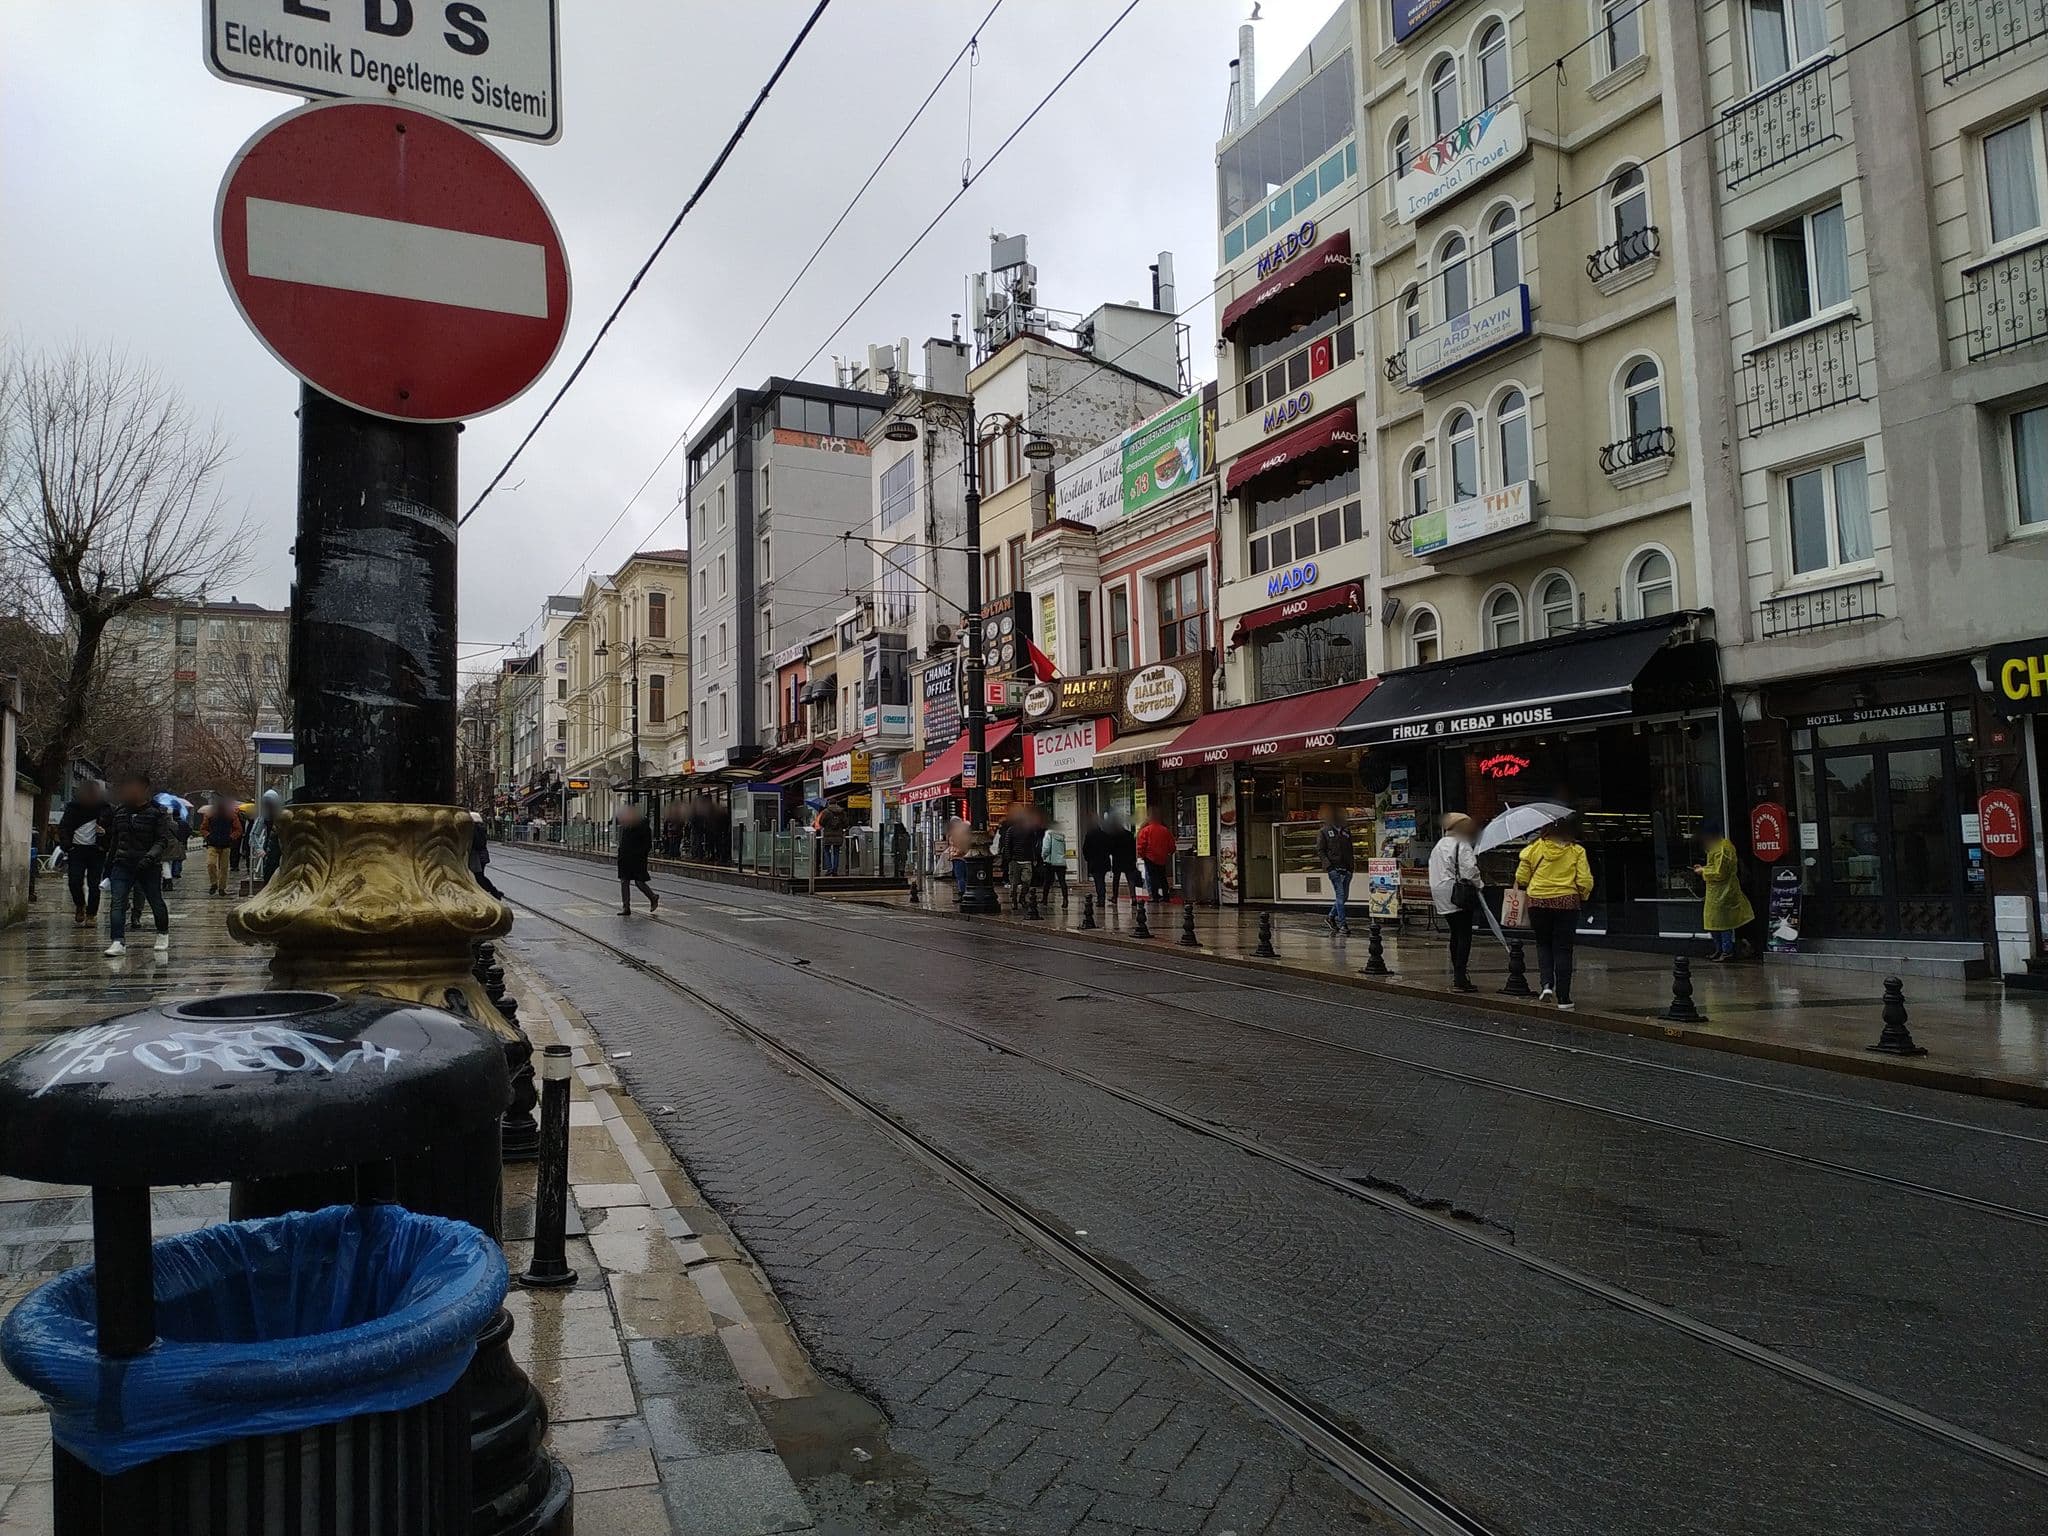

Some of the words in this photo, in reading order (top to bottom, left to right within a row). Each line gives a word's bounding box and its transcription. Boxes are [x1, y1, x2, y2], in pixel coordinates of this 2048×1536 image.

[225, 21, 343, 74] Elektronik
[350, 48, 464, 100] Denetleme
[472, 78, 547, 118] Sistemi
[1407, 169, 1462, 214] Imperial
[1466, 139, 1509, 176] Travel
[1257, 220, 1316, 280] MADO
[1443, 326, 1470, 349] ARD
[1474, 307, 1511, 334] YAYIN
[1263, 391, 1312, 433] MADO
[1331, 431, 1361, 443] MADO
[1260, 453, 1287, 470] MADO
[1057, 477, 1093, 507] Nesilden
[1484, 486, 1522, 513] THY
[1268, 562, 1318, 598] MADO
[1282, 600, 1308, 617] MADO
[924, 662, 953, 684] CHANGE
[2001, 655, 2048, 700] CH
[926, 678, 952, 698] OFFICE
[990, 685, 1002, 698] E
[1451, 715, 1495, 732] KEBAP
[1503, 708, 1553, 725] HOUSE
[1806, 714, 1842, 726] HOTEL
[1853, 701, 1946, 721] SULTANAHMET
[1037, 728, 1093, 756] ECZANE
[1252, 742, 1278, 756] MADO
[1305, 733, 1335, 749] MADO
[1161, 756, 1183, 768] MADO
[1204, 749, 1228, 762] MADO
[1984, 801, 2017, 832] SULTANAHMET
[1757, 841, 1780, 850] HOTEL
[1986, 834, 2018, 844] HOTEL
[1507, 900, 1519, 928] Claro
